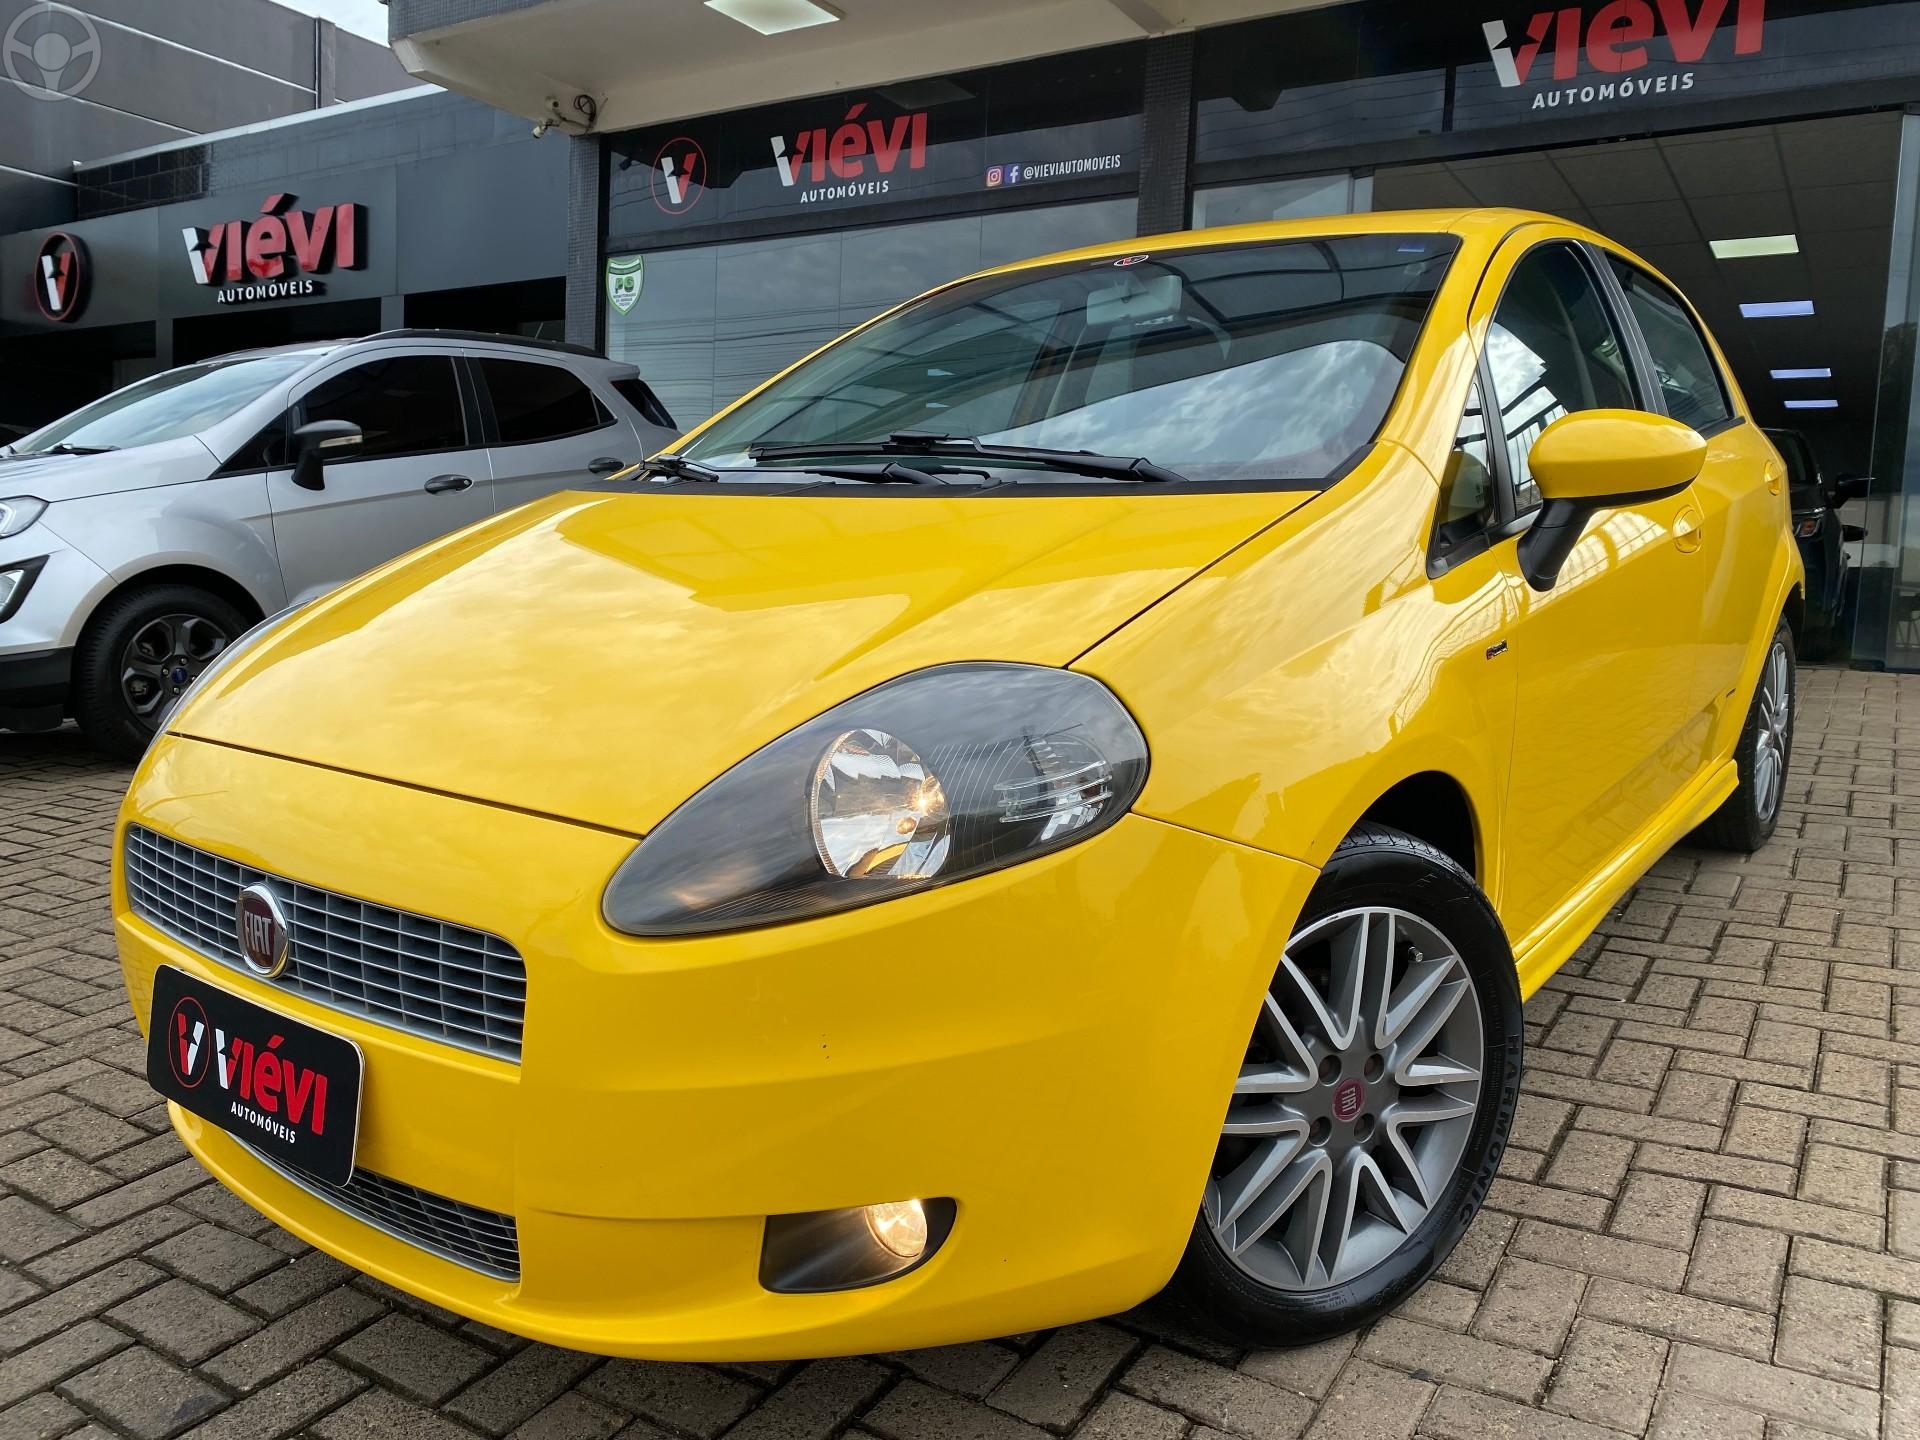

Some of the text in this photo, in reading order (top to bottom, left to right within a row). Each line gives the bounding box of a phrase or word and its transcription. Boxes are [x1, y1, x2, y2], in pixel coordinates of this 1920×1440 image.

[1531, 72, 1695, 109] AUTOMÓVEIS
[1023, 154, 1121, 180] @VIEVIAUTOMOVEIS
[800, 180, 890, 203] AUTOMÓVEIS
[217, 279, 314, 303] AUTOMÓVEIS
[244, 910, 272, 956] FIAT
[1341, 1086, 1357, 1112] FIAT
[230, 1101, 296, 1144] AUTOMÓVEIS
[1459, 1035, 1520, 1226] HARMONIC
